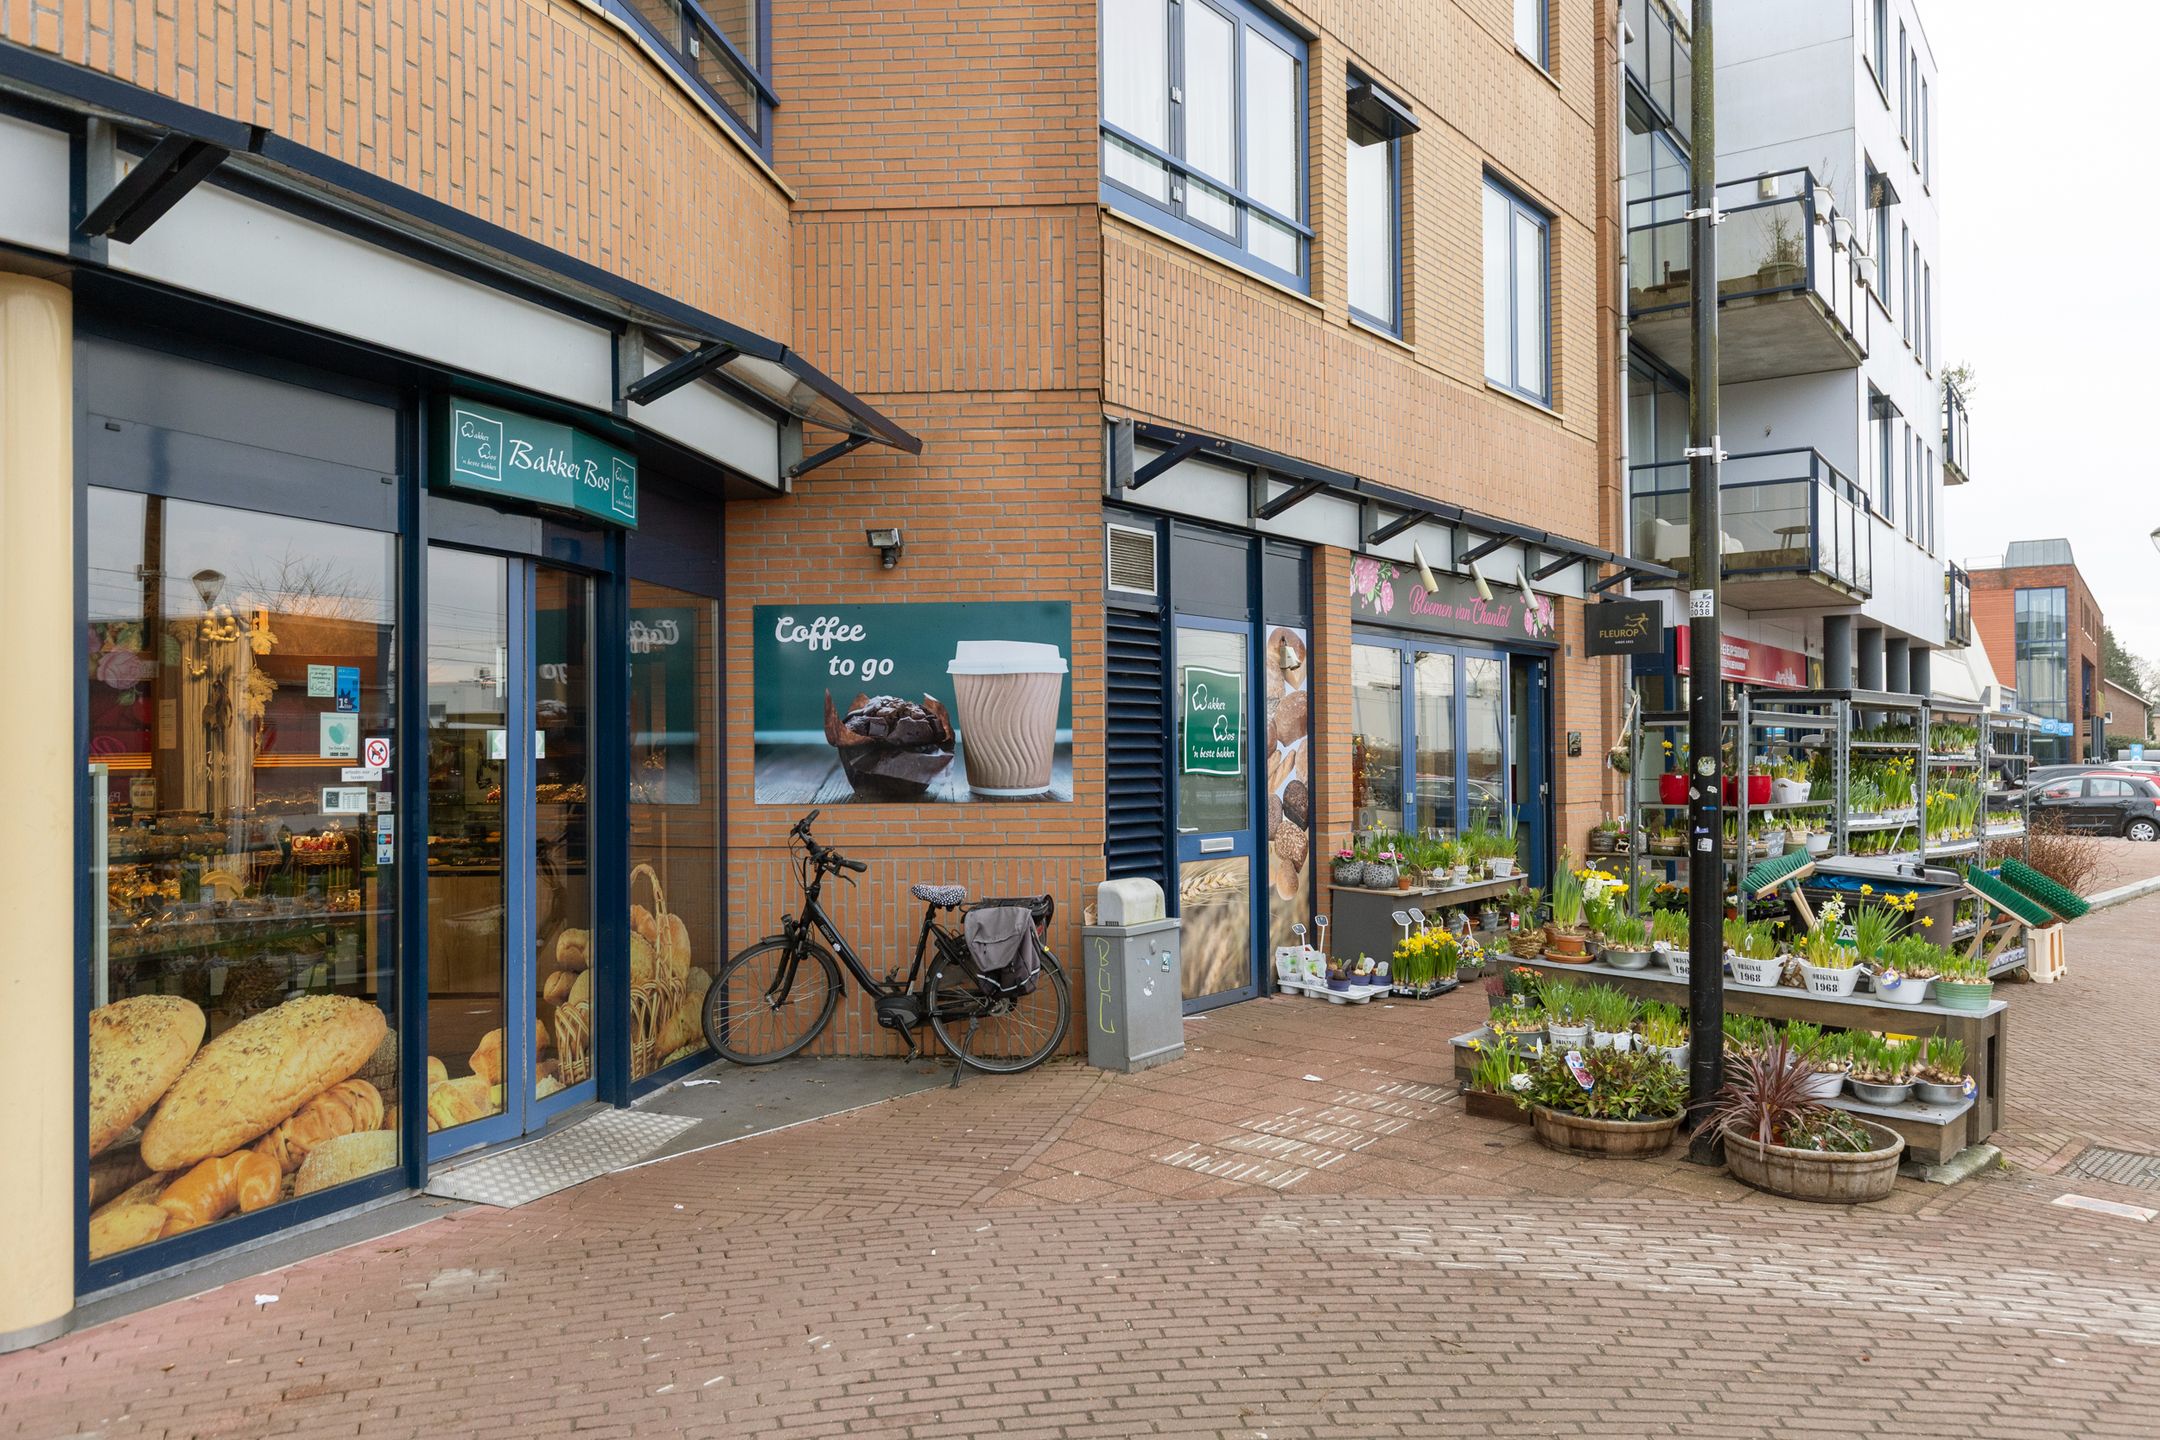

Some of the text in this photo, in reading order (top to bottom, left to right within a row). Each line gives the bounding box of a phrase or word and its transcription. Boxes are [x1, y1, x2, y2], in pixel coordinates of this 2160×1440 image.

[508, 439, 581, 480] Bakker
[584, 459, 610, 491] Bos
[1409, 584, 1513, 627] Bloemen van Chantal
[775, 616, 866, 651] Coffee
[1599, 629, 1639, 638] FLEUROP
[829, 655, 894, 681] to go
[1737, 962, 1762, 971] ORIGINAL
[1739, 972, 1761, 982] 1968
[1812, 973, 1839, 981] ORIGINAL
[1815, 982, 1838, 992] 1968
